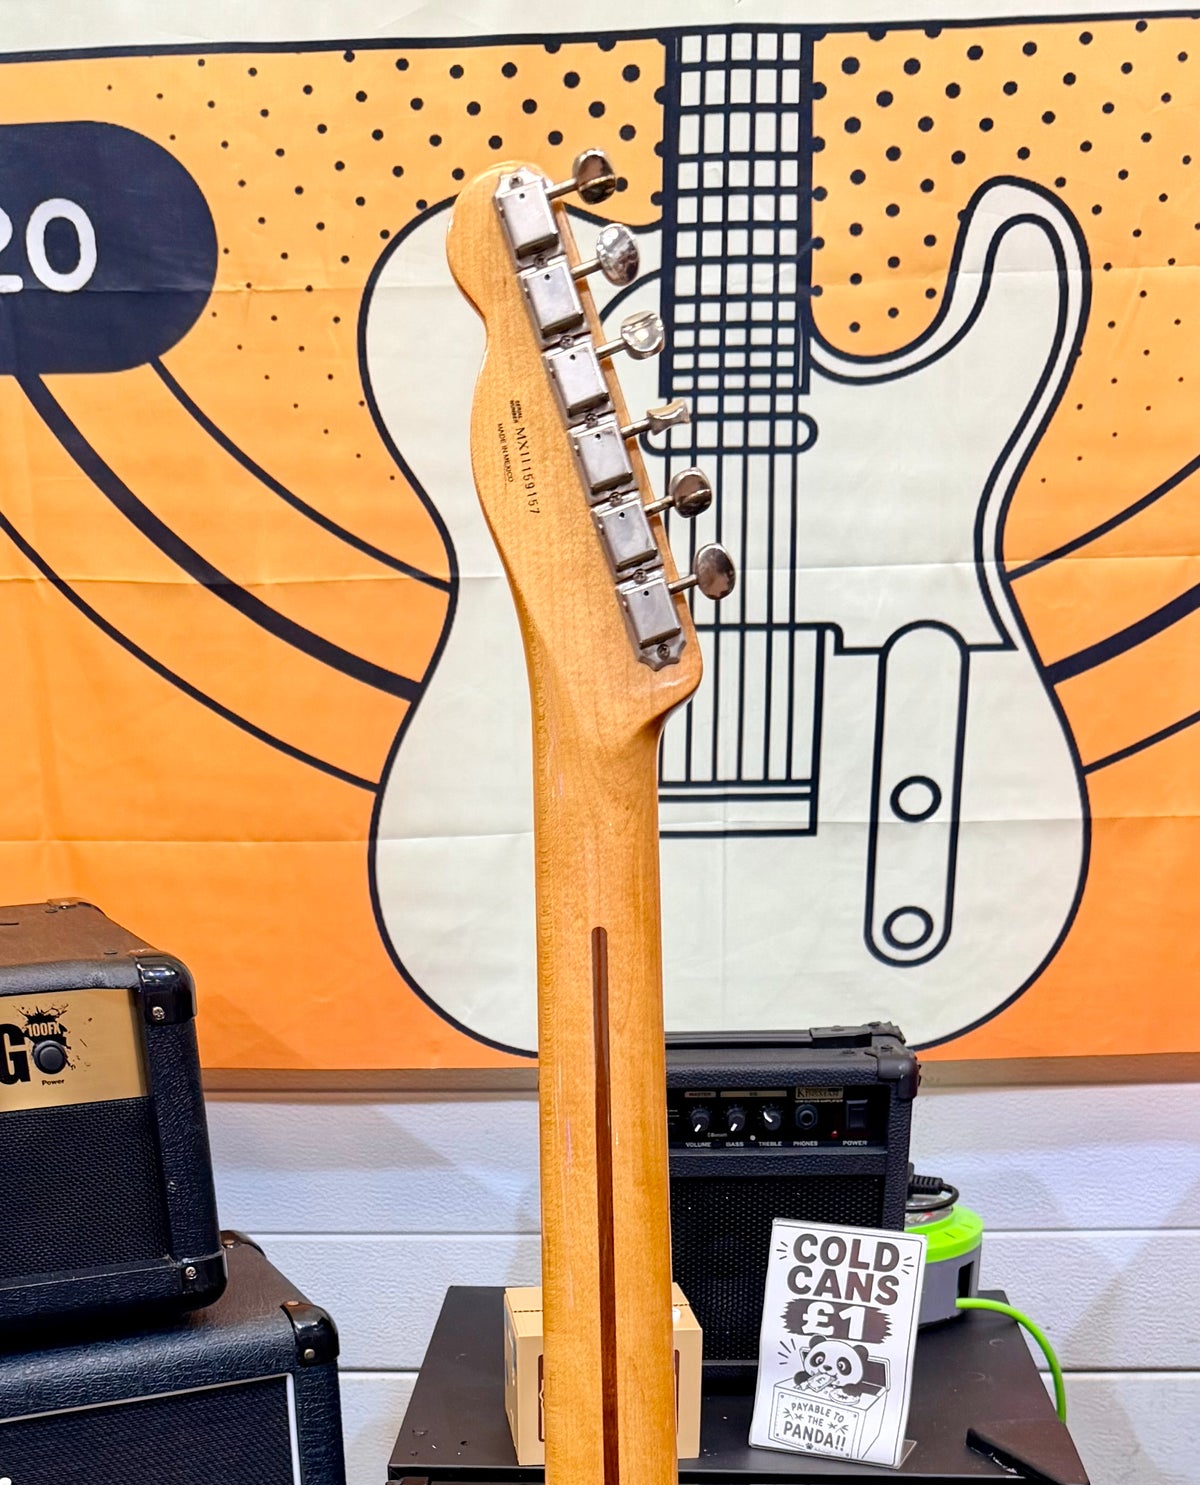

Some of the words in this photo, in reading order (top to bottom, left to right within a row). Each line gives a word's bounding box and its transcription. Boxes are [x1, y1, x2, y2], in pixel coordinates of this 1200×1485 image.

[498, 423, 506, 444] MADE
[504, 454, 514, 482] MEXICO
[27, 1021, 61, 1037] 100FX
[793, 1233, 900, 1272] COLD
[787, 1265, 900, 1306] CANS
[802, 1301, 866, 1340] £1
[791, 1403, 832, 1417] PAYABLE
[834, 1412, 845, 1423] TO
[808, 1415, 824, 1427] THE
[783, 1421, 846, 1451] PANDA!!
